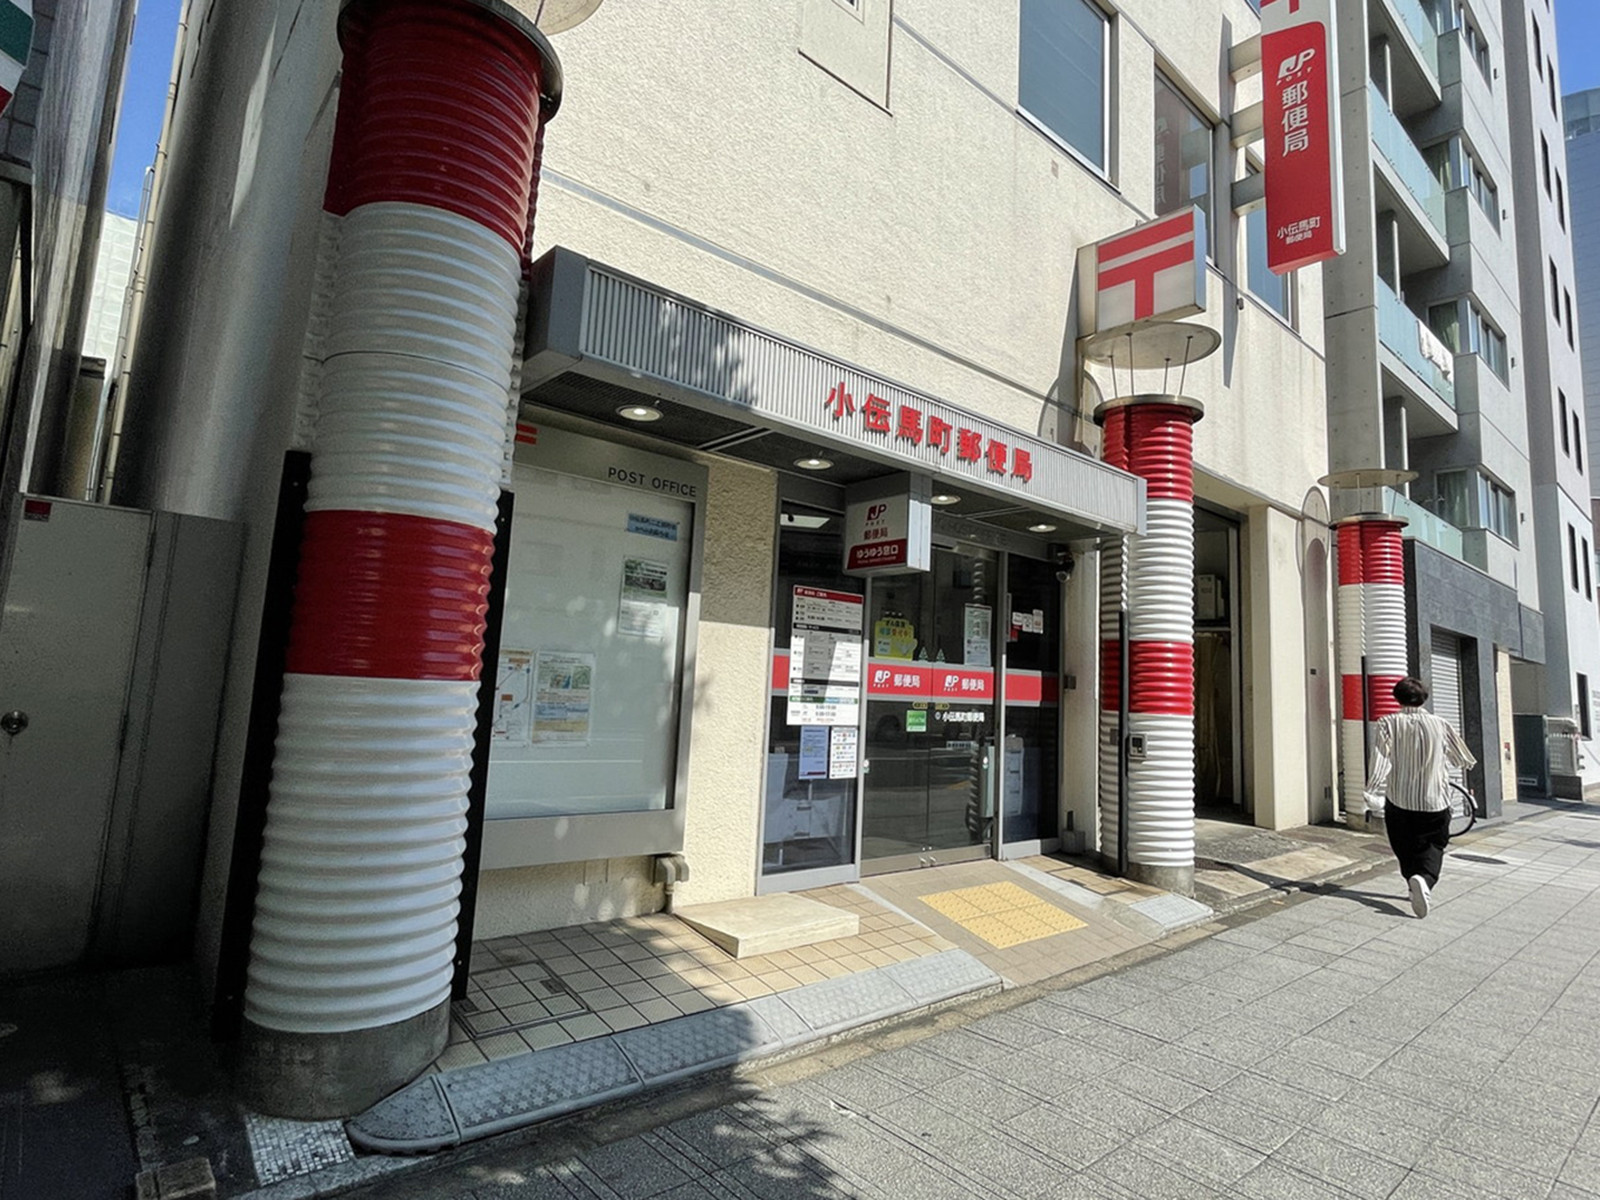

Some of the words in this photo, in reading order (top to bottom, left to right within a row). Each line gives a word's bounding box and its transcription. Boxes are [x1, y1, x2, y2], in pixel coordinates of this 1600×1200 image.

[1282, 80, 1309, 157] 郵便局
[1277, 216, 1320, 239] 小伝馬町
[824, 381, 1032, 483] 小伝馬町郵便局
[608, 467, 645, 485] POST
[652, 477, 697, 498] OFFICE
[894, 673, 920, 688] 郵便局
